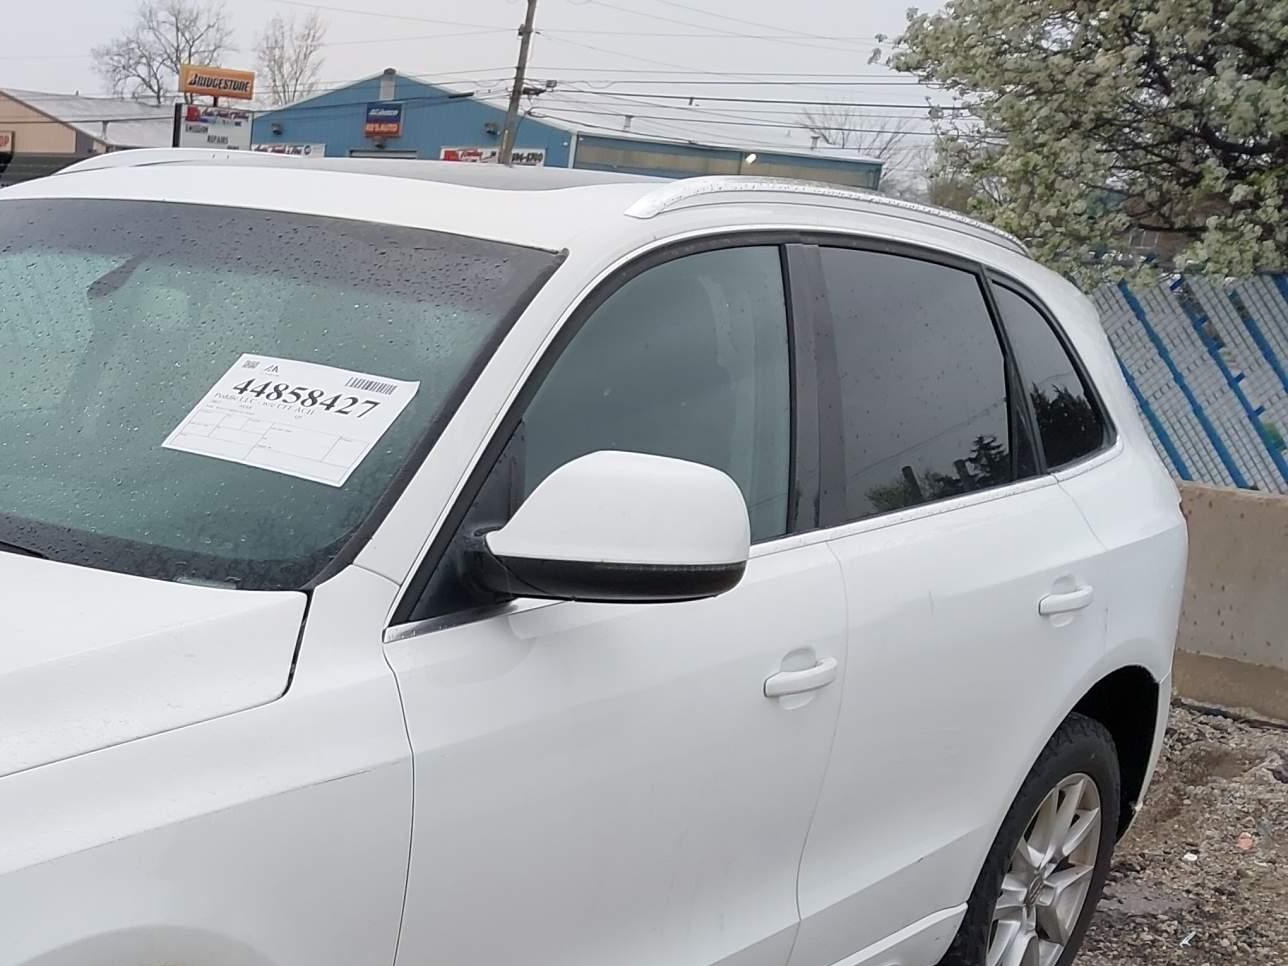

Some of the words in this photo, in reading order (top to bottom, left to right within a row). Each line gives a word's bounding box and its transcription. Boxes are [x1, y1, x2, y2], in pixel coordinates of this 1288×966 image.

[188, 74, 249, 92] BRIDGESTONE
[207, 135, 229, 145] REPAIRS
[233, 378, 381, 418] 44858427
